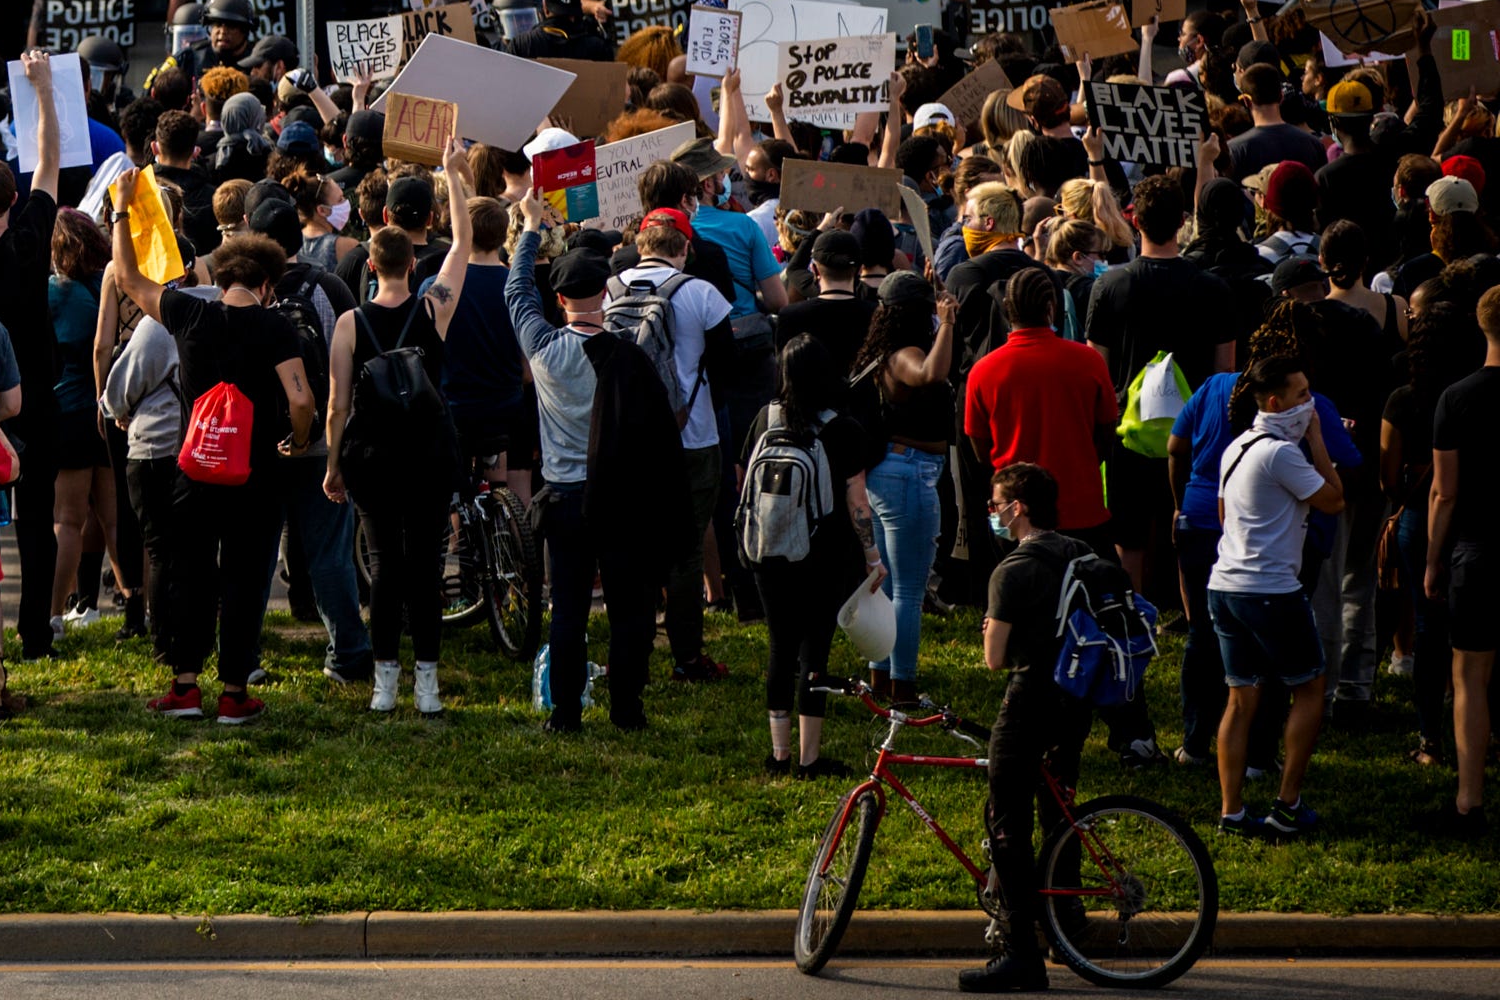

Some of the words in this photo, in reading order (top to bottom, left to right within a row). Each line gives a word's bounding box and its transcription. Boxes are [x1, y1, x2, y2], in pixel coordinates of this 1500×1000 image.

[971, 3, 1058, 33] OLICE
[336, 21, 391, 43] BLACK
[699, 27, 714, 61] FLOYD
[717, 17, 731, 62] GEORGE
[339, 38, 397, 60] LIVES
[333, 54, 393, 77] MATTER
[813, 62, 872, 84] POLICE
[1090, 82, 1204, 113] BLACK
[1096, 105, 1202, 140] LIVES
[609, 143, 633, 161] YOU
[641, 134, 666, 151] ARE
[597, 157, 644, 180] EUTRAL
